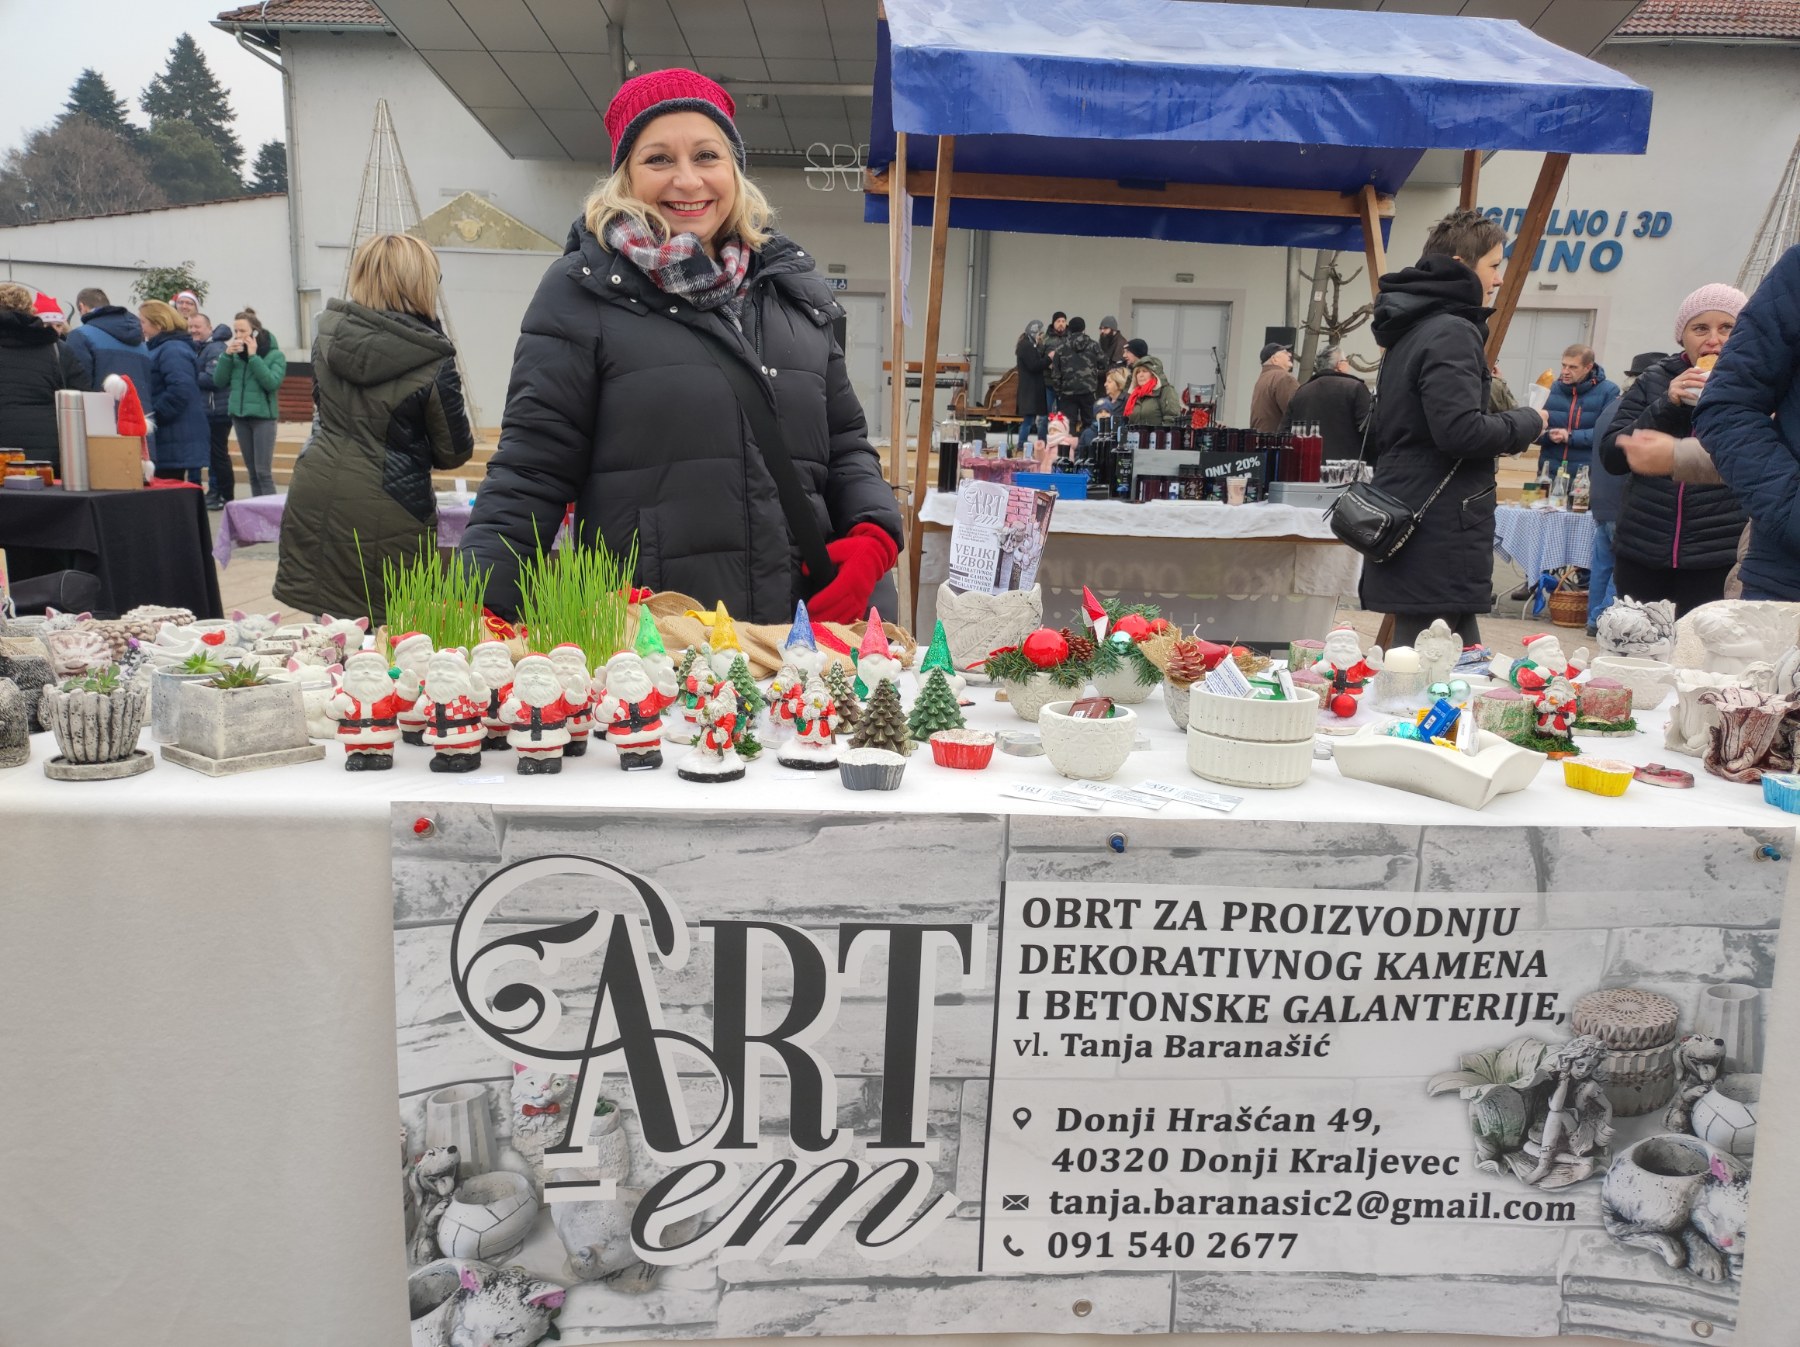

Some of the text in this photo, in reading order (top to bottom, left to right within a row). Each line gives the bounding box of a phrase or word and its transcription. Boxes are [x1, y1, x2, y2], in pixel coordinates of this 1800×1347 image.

[1633, 211, 1673, 238] 3D
[1205, 462, 1233, 478] ONLY
[1235, 455, 1261, 472] 20%
[955, 543, 996, 560] VELIKI
[956, 555, 994, 571] IZBOR
[1022, 897, 1521, 944] OBRT ZA PROIZVODNJU
[1018, 943, 1548, 981] DEKORATIVNOG KAMENA
[450, 855, 974, 1154] ART
[1015, 989, 1566, 1027] I BETONSKE GALANTERIJE,
[1013, 1032, 1331, 1064] vl. Tanja Baranašić
[1055, 1105, 1381, 1139] Donji Hrašćan 49,
[1051, 1147, 1460, 1181] 40320 Donji Kraljevec
[630, 1158, 951, 1254] em
[1049, 1187, 1576, 1225] tanja.baranasic2@gmail.com
[1047, 1230, 1299, 1260] 091 540 2677
